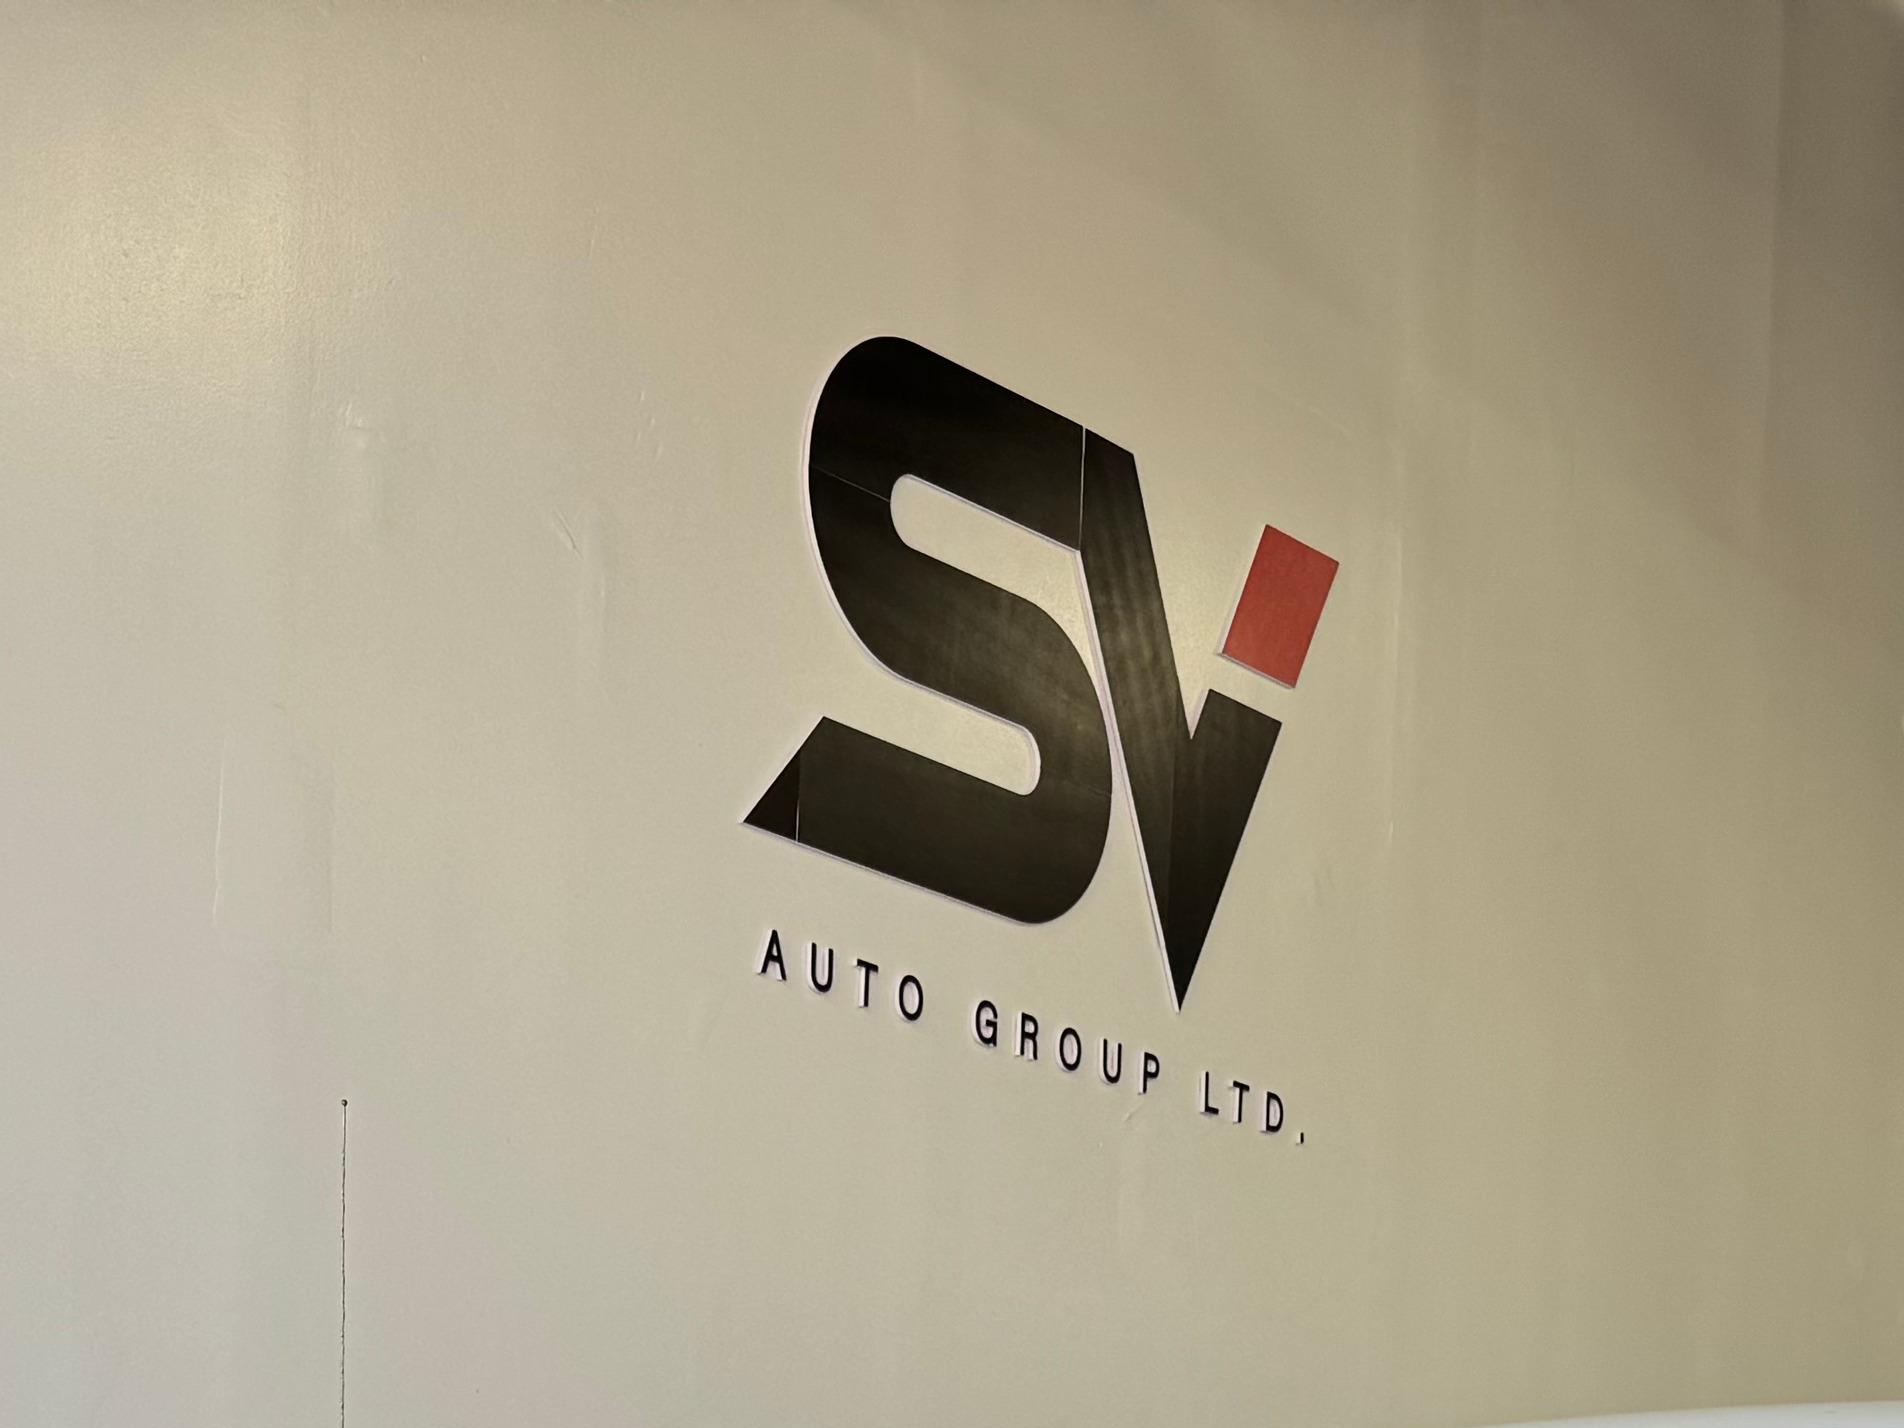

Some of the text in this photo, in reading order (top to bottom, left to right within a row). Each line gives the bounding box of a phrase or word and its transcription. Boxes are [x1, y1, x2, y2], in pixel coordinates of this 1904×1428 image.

[758, 929, 1305, 1145] AUTO GROUP LTD.
